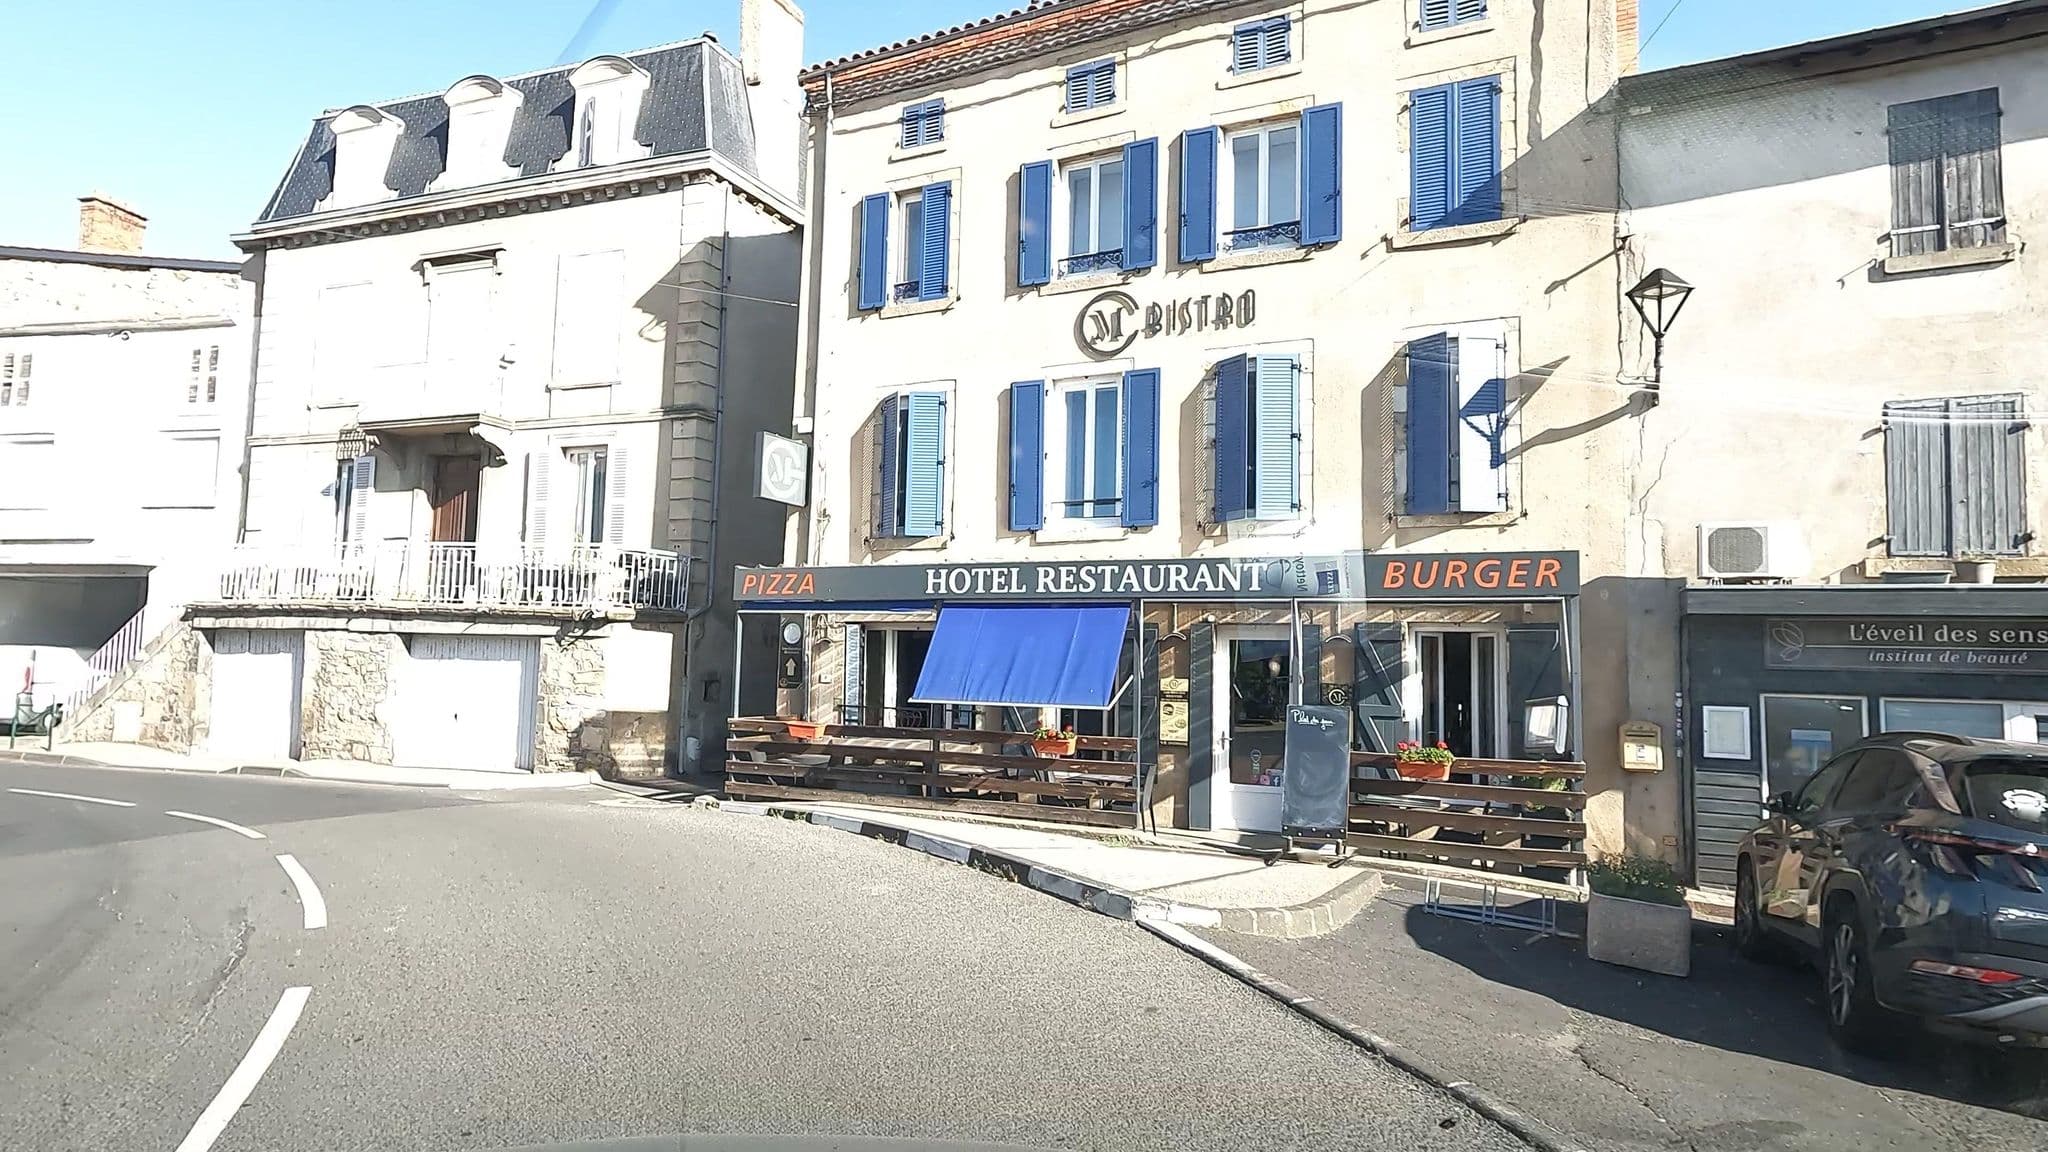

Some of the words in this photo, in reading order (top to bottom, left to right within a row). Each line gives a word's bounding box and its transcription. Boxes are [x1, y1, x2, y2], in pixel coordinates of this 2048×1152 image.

[1141, 289, 1256, 339] BISTRO
[741, 573, 815, 595] PIZZA
[926, 568, 1026, 595] HOTEL
[1036, 565, 1265, 593] RESTAURANT
[1383, 559, 1561, 589] BURGER
[1850, 624, 1924, 642] L'éveil
[1934, 624, 1978, 642] des
[1989, 629, 2048, 643] sens
[1868, 651, 1932, 663] institut
[1939, 651, 1961, 663] de
[1966, 652, 2029, 665] beauté
